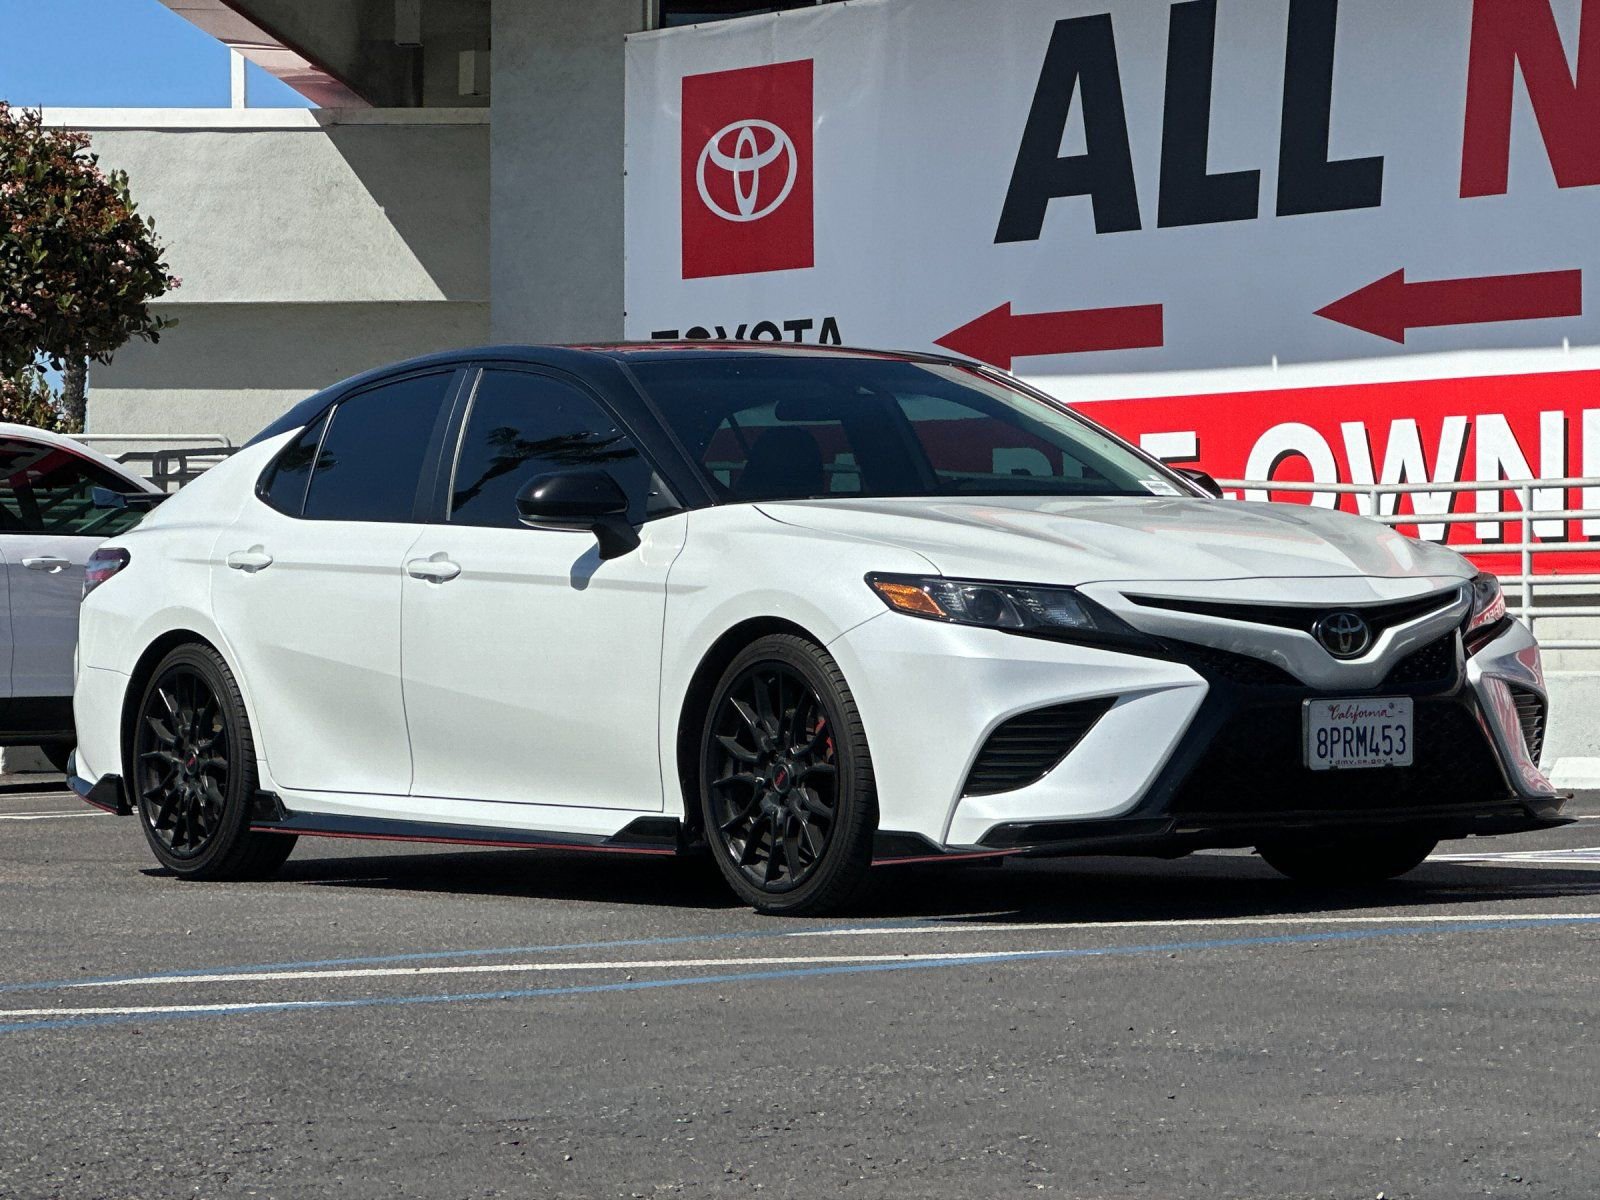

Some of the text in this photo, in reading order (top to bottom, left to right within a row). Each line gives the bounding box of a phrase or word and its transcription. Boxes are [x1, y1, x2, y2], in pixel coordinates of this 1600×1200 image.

[994, 0, 1384, 244] ALL
[651, 316, 842, 345] OTA
[1328, 704, 1393, 724] California
[1317, 725, 1406, 758] 8PRM453
